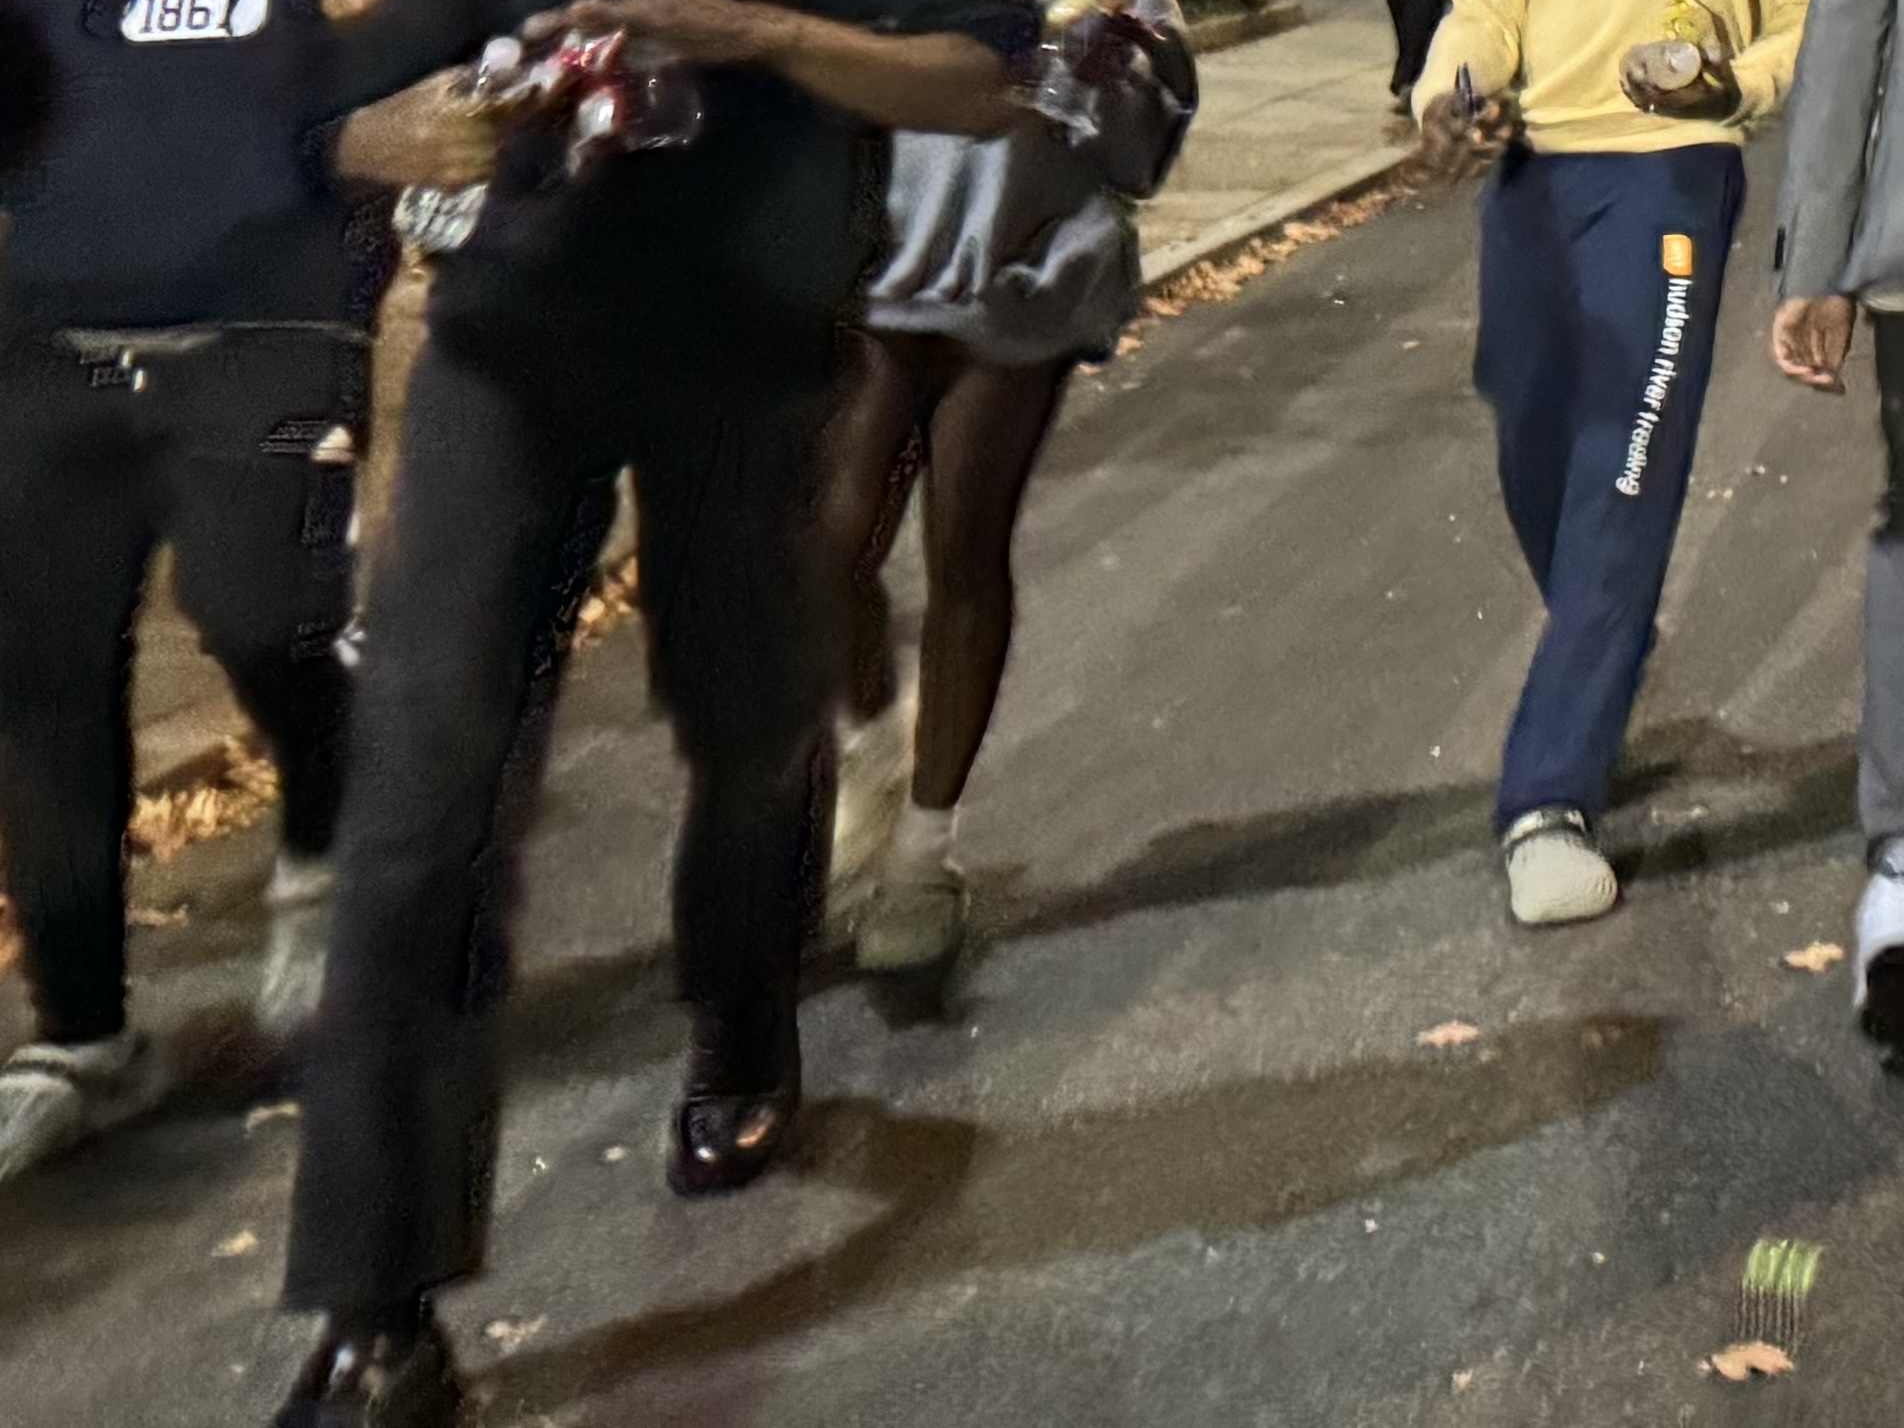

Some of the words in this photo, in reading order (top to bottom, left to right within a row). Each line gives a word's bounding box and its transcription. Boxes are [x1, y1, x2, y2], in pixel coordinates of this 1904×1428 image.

[1657, 277, 1693, 356] hudson
[1643, 358, 1677, 411] river
[1615, 411, 1661, 496] trading
